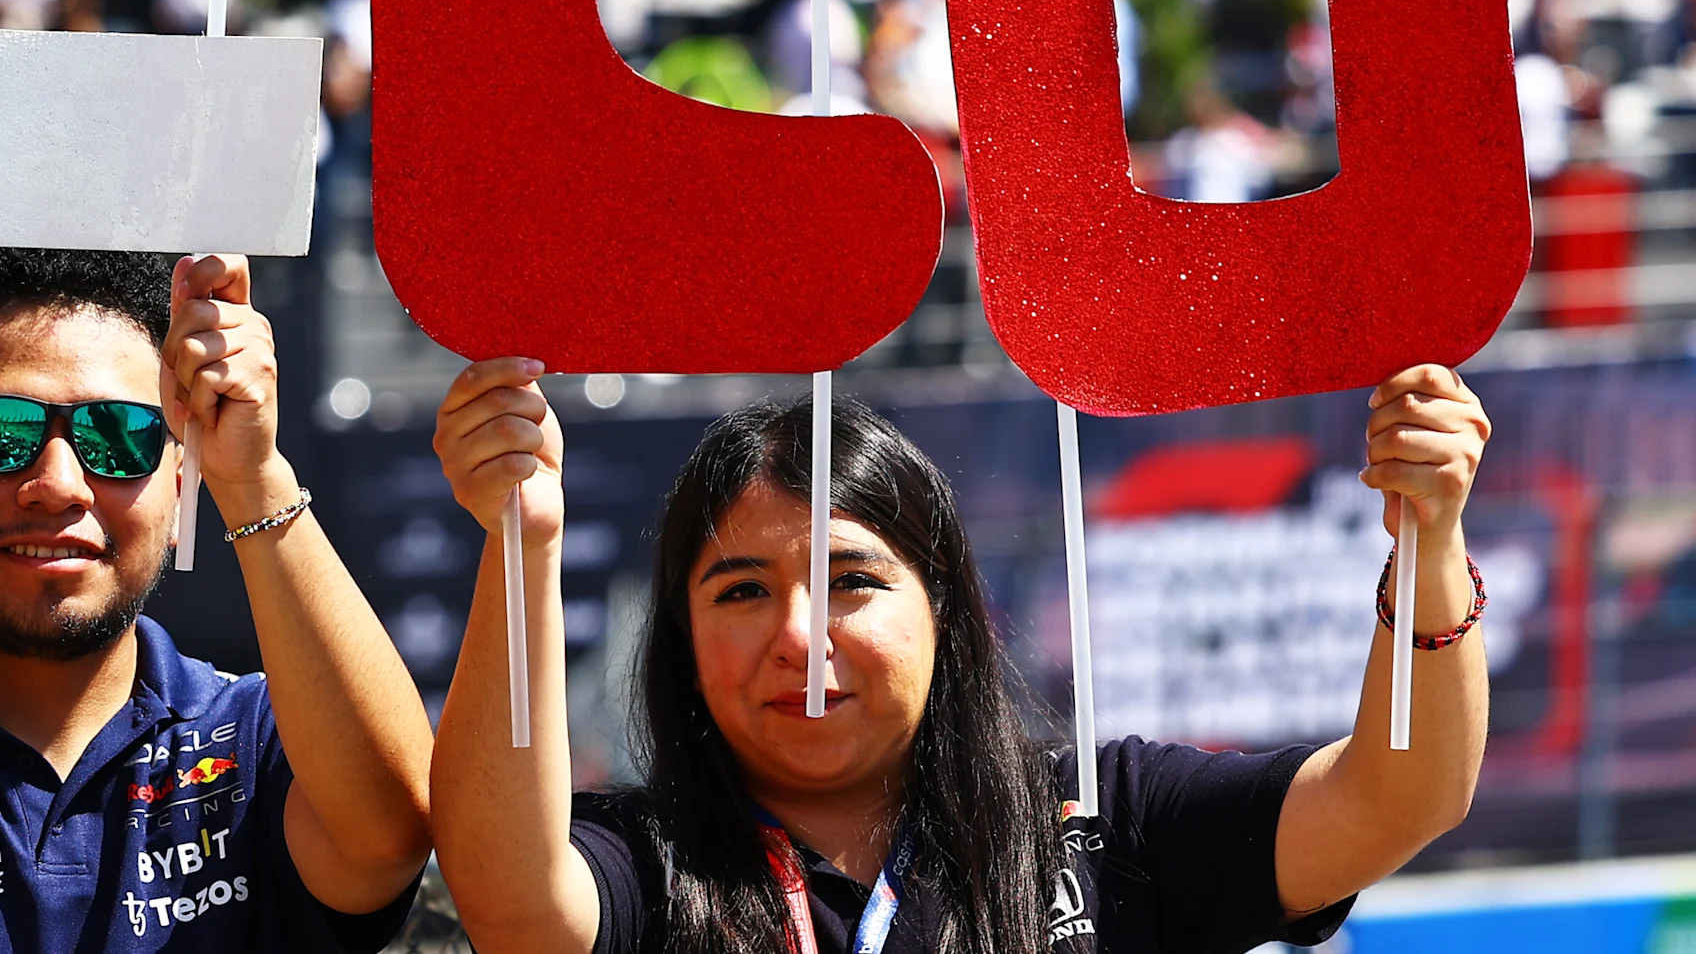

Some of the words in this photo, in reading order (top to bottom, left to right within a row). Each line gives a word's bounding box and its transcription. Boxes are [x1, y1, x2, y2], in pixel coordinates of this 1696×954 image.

[125, 788, 246, 830] RCING
[138, 828, 230, 883] BYBIT
[149, 876, 249, 927] Tezos
